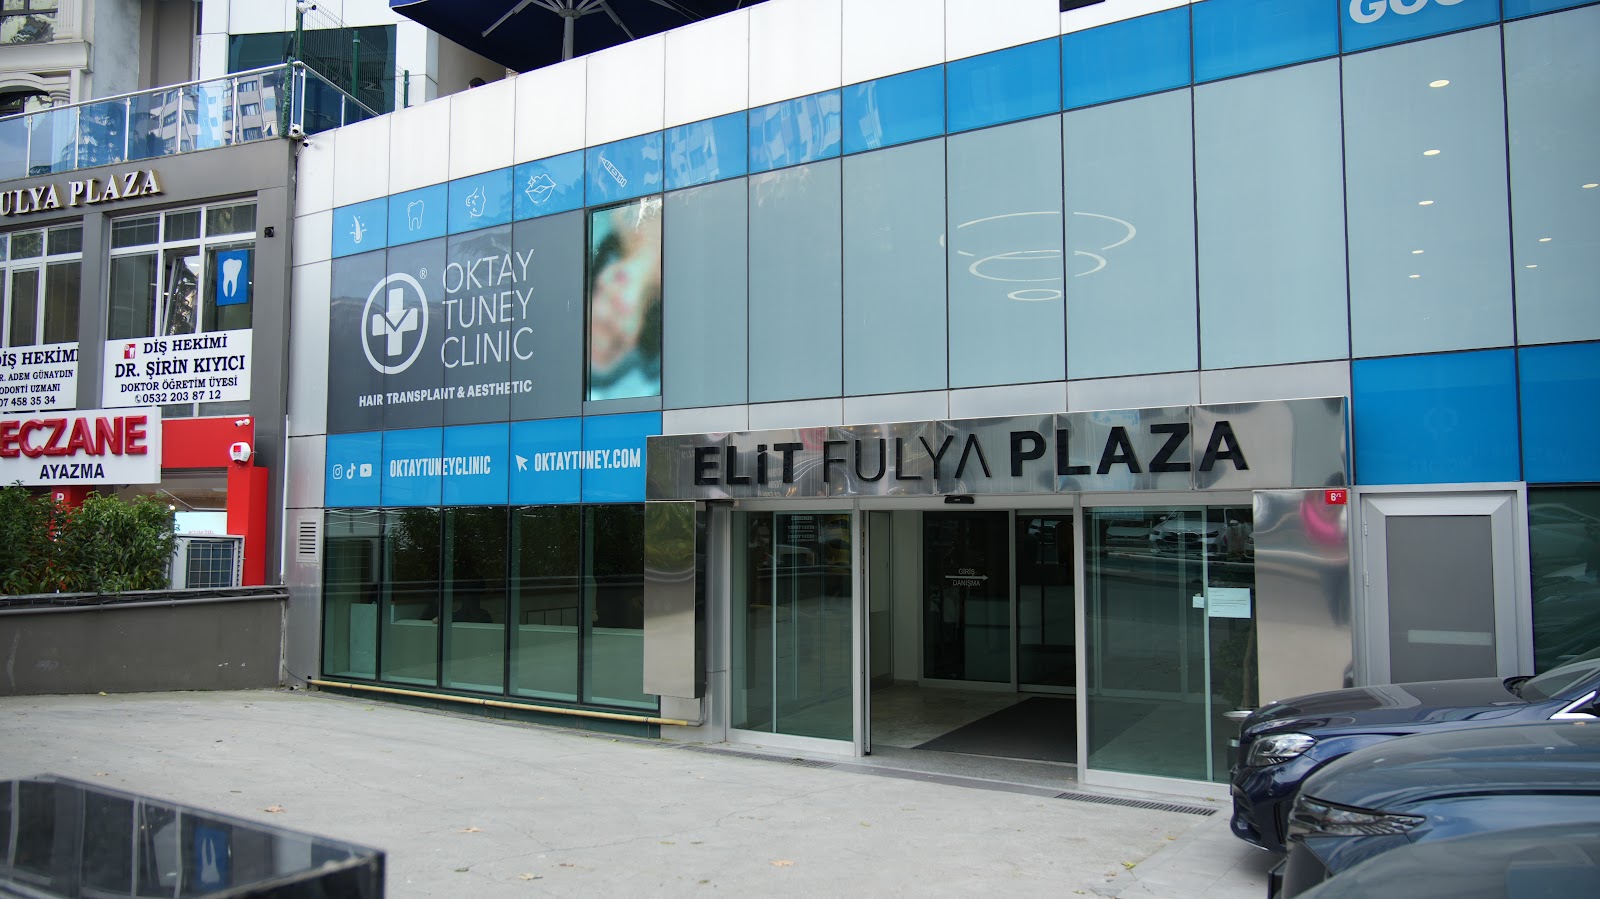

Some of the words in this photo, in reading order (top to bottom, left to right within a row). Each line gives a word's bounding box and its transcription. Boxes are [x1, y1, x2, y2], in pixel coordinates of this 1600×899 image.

[0, 184, 61, 216] ULYA
[69, 170, 161, 206] PLAZA
[442, 248, 535, 294] OKTAY
[441, 287, 535, 330] TUNEY
[143, 339, 168, 356] DİŞ
[172, 334, 228, 351] HEKİMİ
[440, 326, 535, 369] CLINIC
[0, 350, 17, 370] İŞ
[114, 362, 140, 379] DR.
[146, 356, 188, 380] ŞİRİN
[193, 354, 246, 373] KIYICI
[8, 372, 31, 382] ADEM
[32, 369, 74, 380] GÜNAYDIN
[120, 381, 160, 393] DOKTOR
[162, 377, 206, 391] ÖĞRETİM
[208, 374, 238, 388] ÜYESİ
[30, 383, 61, 393] UZMANI
[142, 392, 167, 403] 0532
[170, 391, 189, 402] 203
[192, 390, 205, 401] 87
[209, 389, 222, 400] 12
[358, 393, 384, 408] HAIR
[386, 387, 457, 405] TRANSPLANT
[456, 386, 466, 399] &
[467, 379, 533, 398] AESTHETIC
[10, 396, 28, 407] 458
[30, 396, 42, 406] 35
[44, 395, 56, 405] 34
[0, 414, 148, 459] ECZANE
[534, 447, 641, 472] OKTAYTUNEY.COM
[823, 434, 992, 483] FULYA
[1010, 420, 1250, 478] PLAZA
[39, 463, 105, 480] AYAZMA
[389, 455, 492, 478] OKTAYTUNEYCLINIC
[958, 567, 976, 577] GİRİŞ
[952, 579, 981, 588] DANIŞMA
